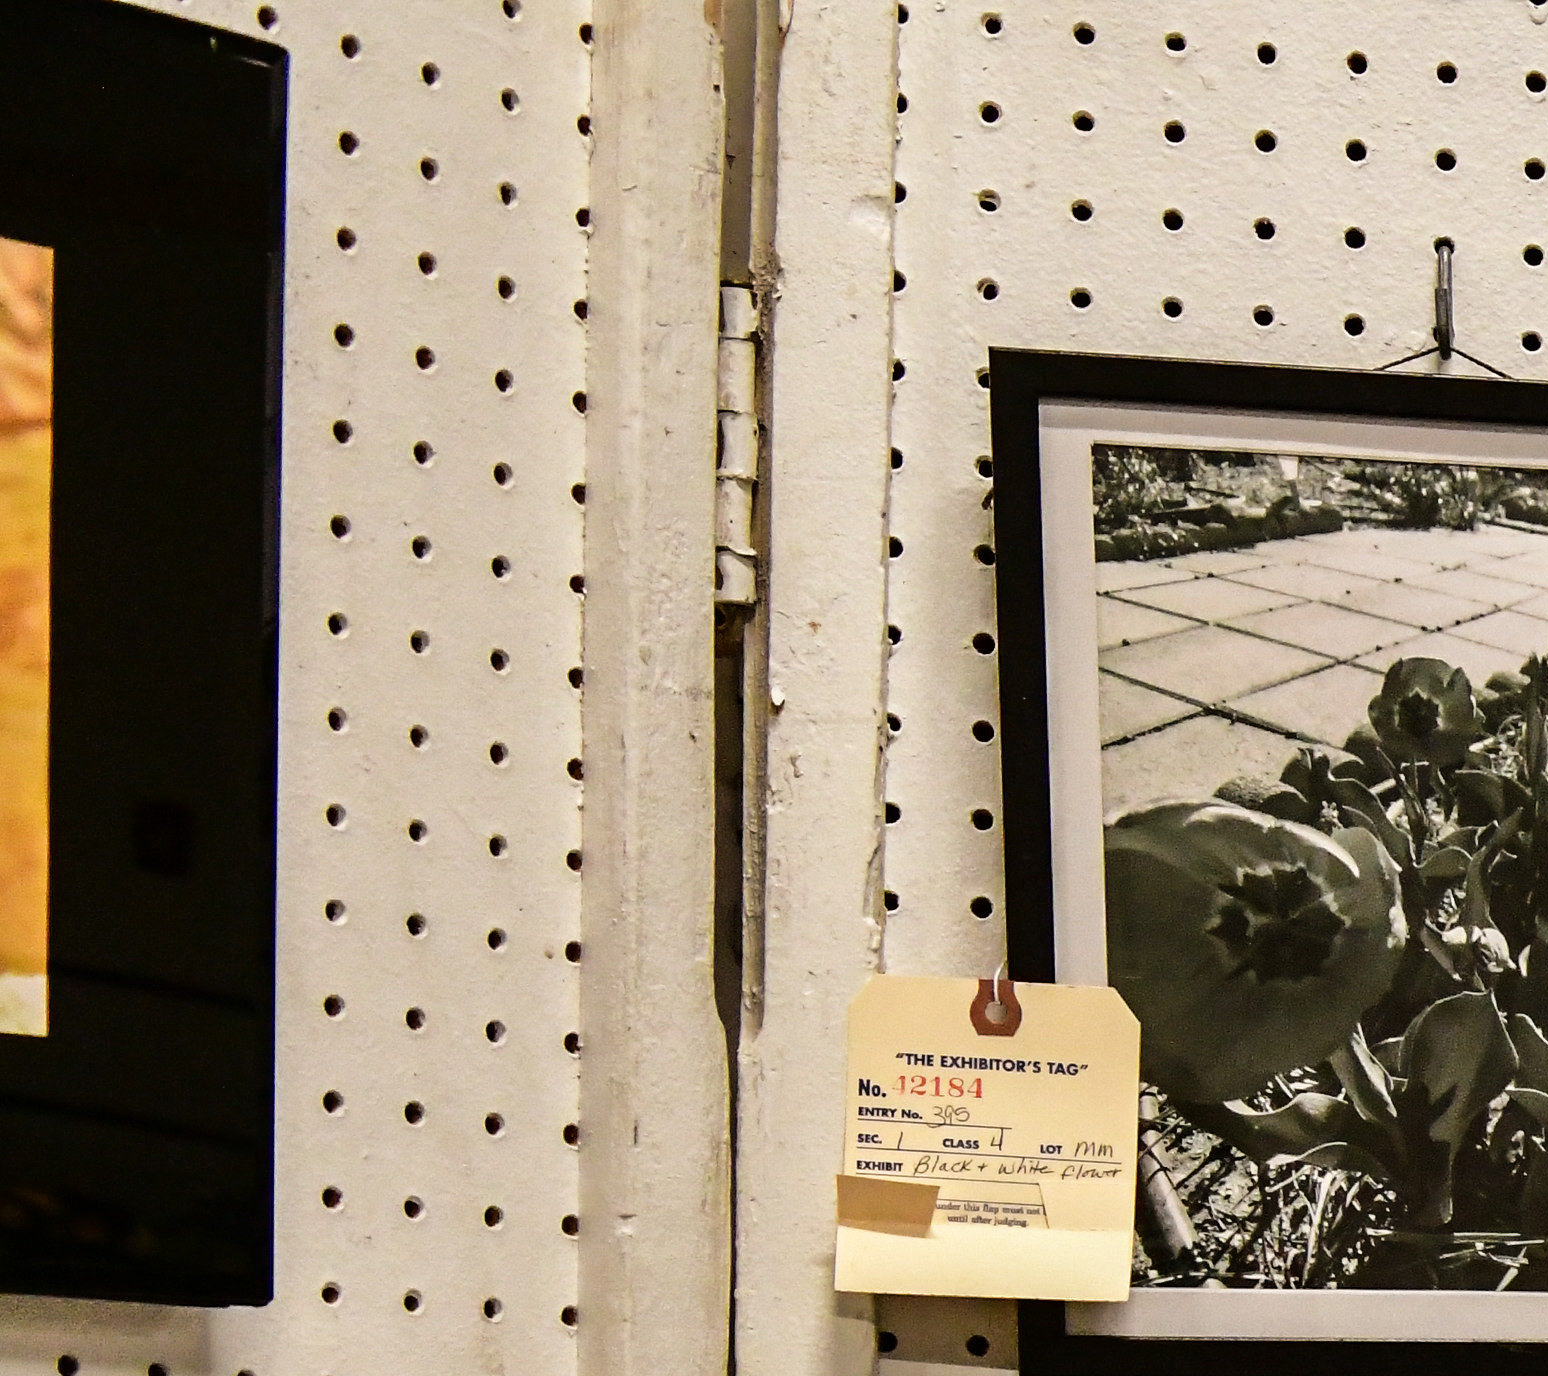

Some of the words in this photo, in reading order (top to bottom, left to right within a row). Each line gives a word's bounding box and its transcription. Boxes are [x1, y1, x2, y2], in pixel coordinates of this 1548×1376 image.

[857, 1078, 887, 1098] No.
[857, 1106, 898, 1118] ENTRY
[901, 1109, 923, 1120] No.
[927, 1105, 970, 1128] 395
[857, 1133, 883, 1145] SEC.
[942, 1138, 980, 1150] CLASS
[990, 1128, 1004, 1151] 4
[1040, 1144, 1063, 1155] LOT
[856, 1160, 904, 1172] EXHIBIT
[913, 1155, 972, 1176] Black
